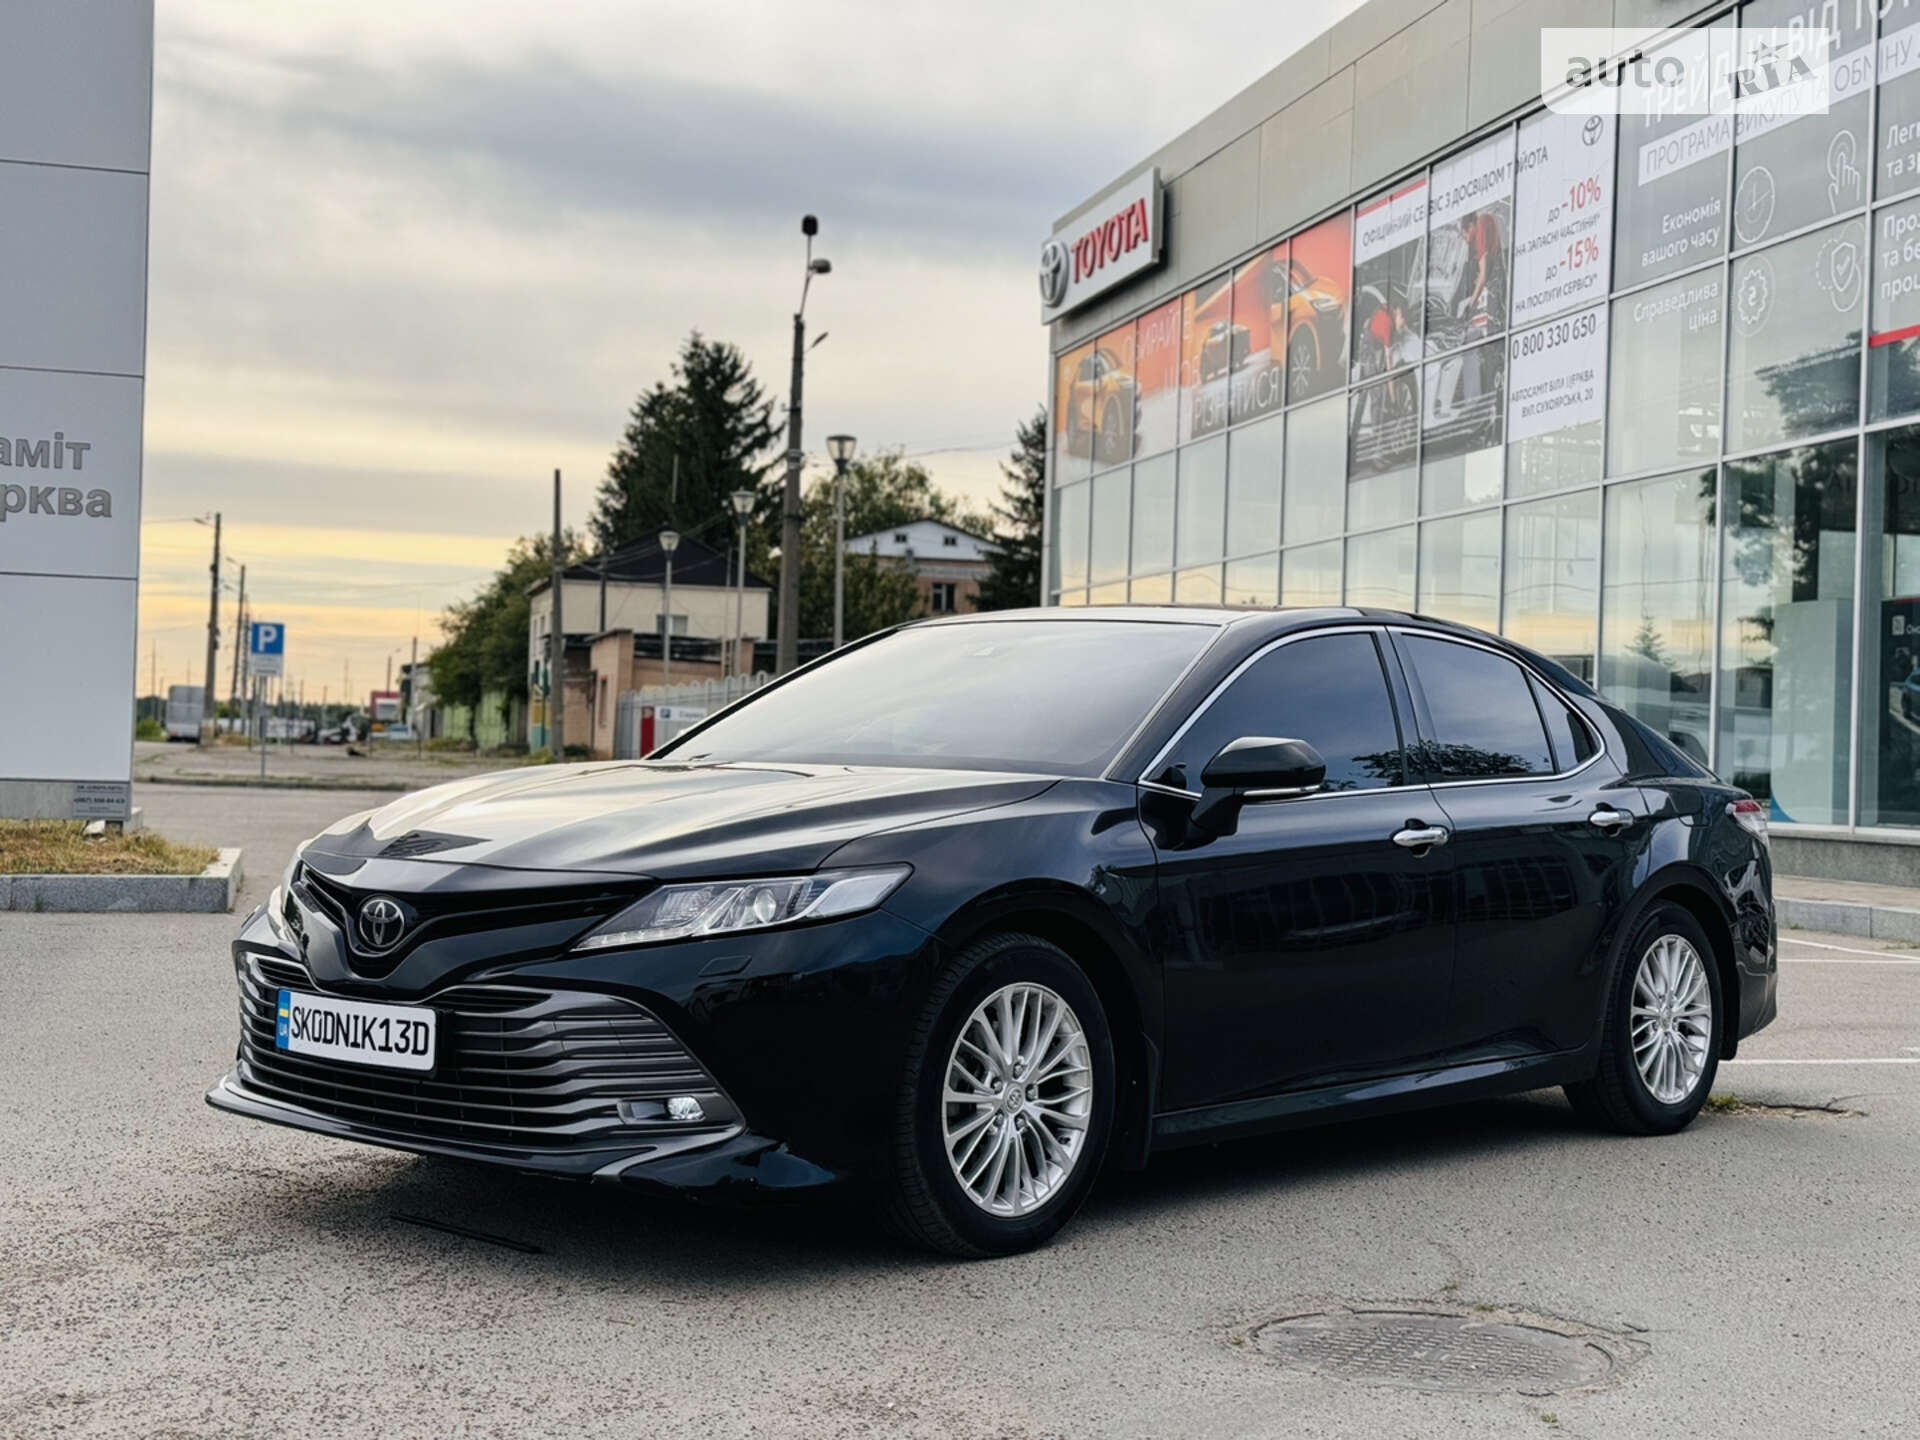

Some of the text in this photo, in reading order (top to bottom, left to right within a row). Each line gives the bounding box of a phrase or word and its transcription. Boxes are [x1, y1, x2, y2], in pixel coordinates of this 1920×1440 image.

[1646, 116, 1731, 175] ПРОГРАМА
[1886, 159, 1903, 178] та
[1561, 175, 1601, 212] -10%
[1662, 197, 1721, 234] Економія
[1071, 198, 1148, 284] TOYOTA
[1560, 234, 1599, 271] -15%
[1642, 226, 1720, 267] вашого часу
[1882, 249, 1899, 269] та
[1633, 282, 1719, 322] Справедлива
[1689, 307, 1718, 332] ціна
[1512, 313, 1597, 360] 0 800 330 650
[259, 625, 277, 651] P
